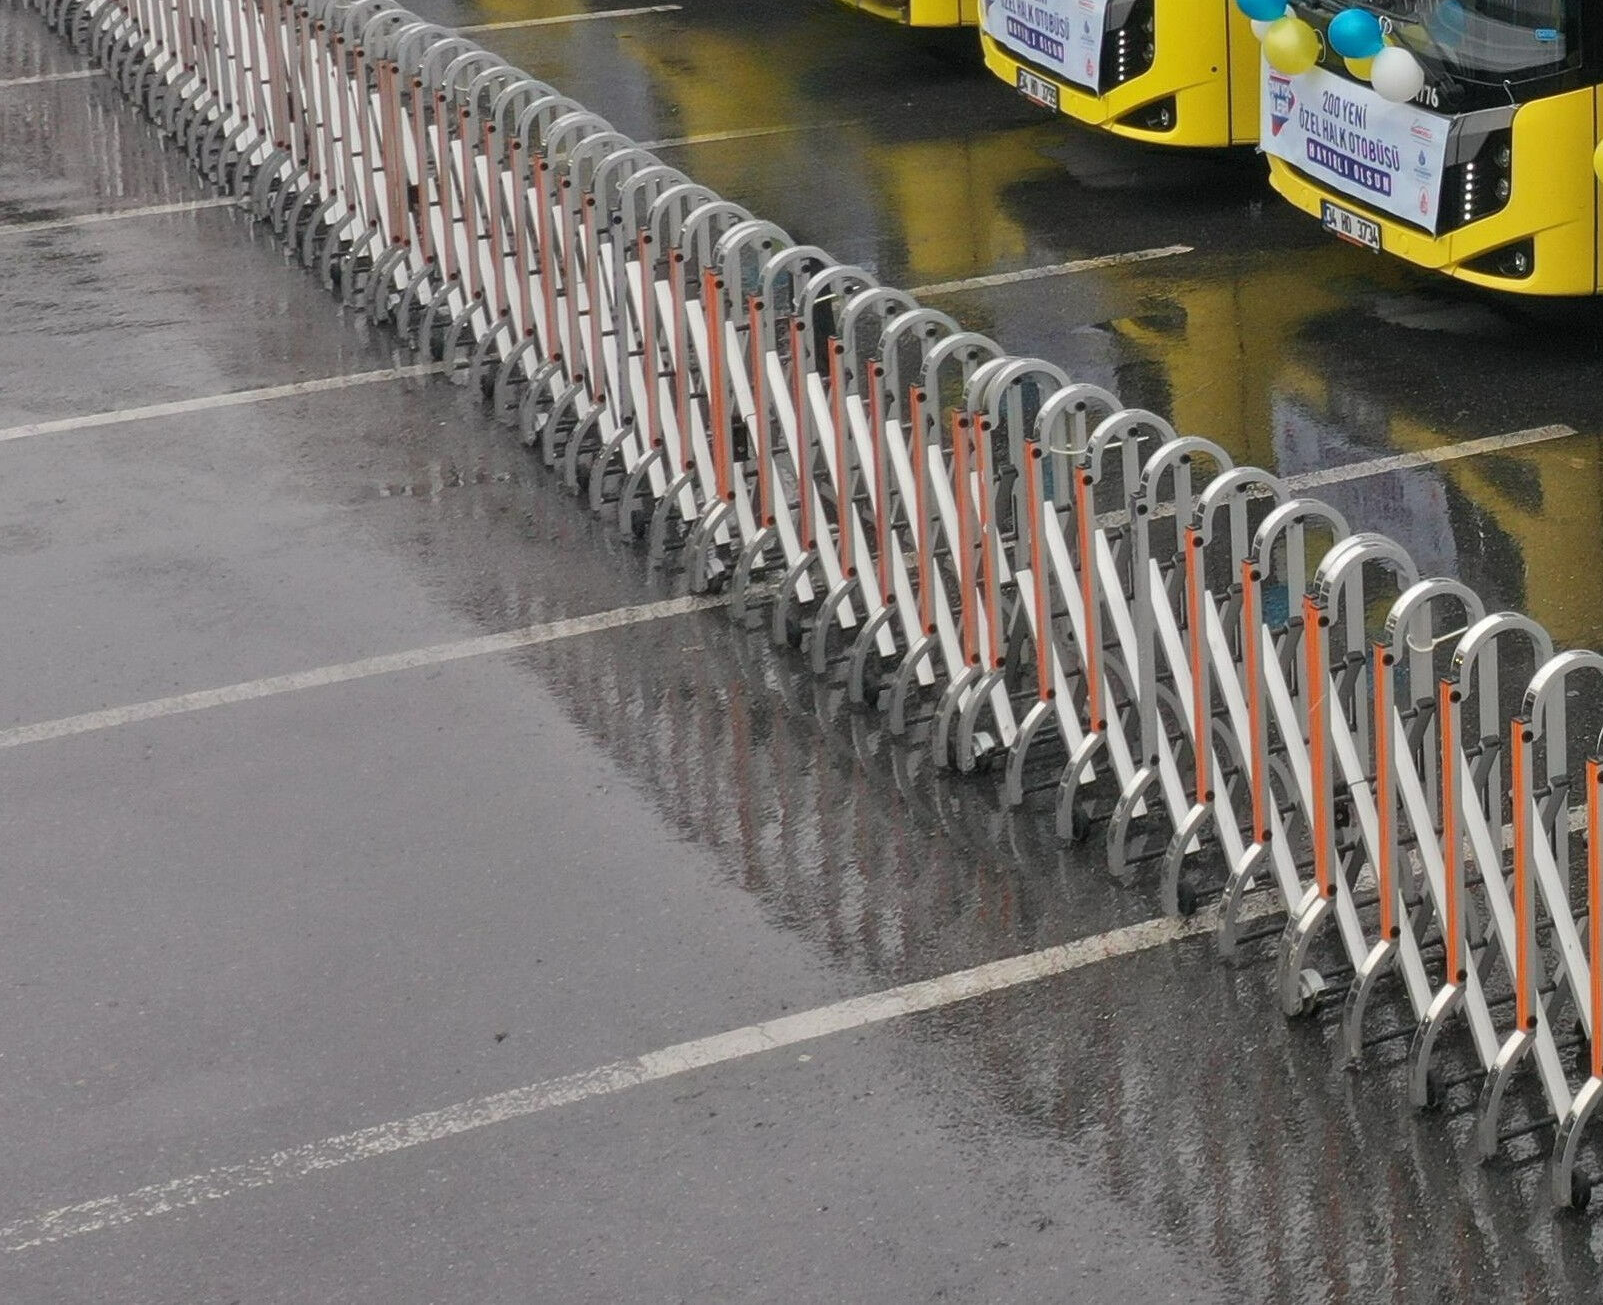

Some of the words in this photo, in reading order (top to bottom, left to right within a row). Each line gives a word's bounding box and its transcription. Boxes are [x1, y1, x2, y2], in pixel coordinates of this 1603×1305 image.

[1300, 103, 1322, 138] ÖZEL
[1322, 119, 1347, 152] HALK
[1350, 131, 1401, 173] OTOBÜSÜ
[1322, 90, 1340, 119] 200
[1342, 97, 1368, 131] YENİ
